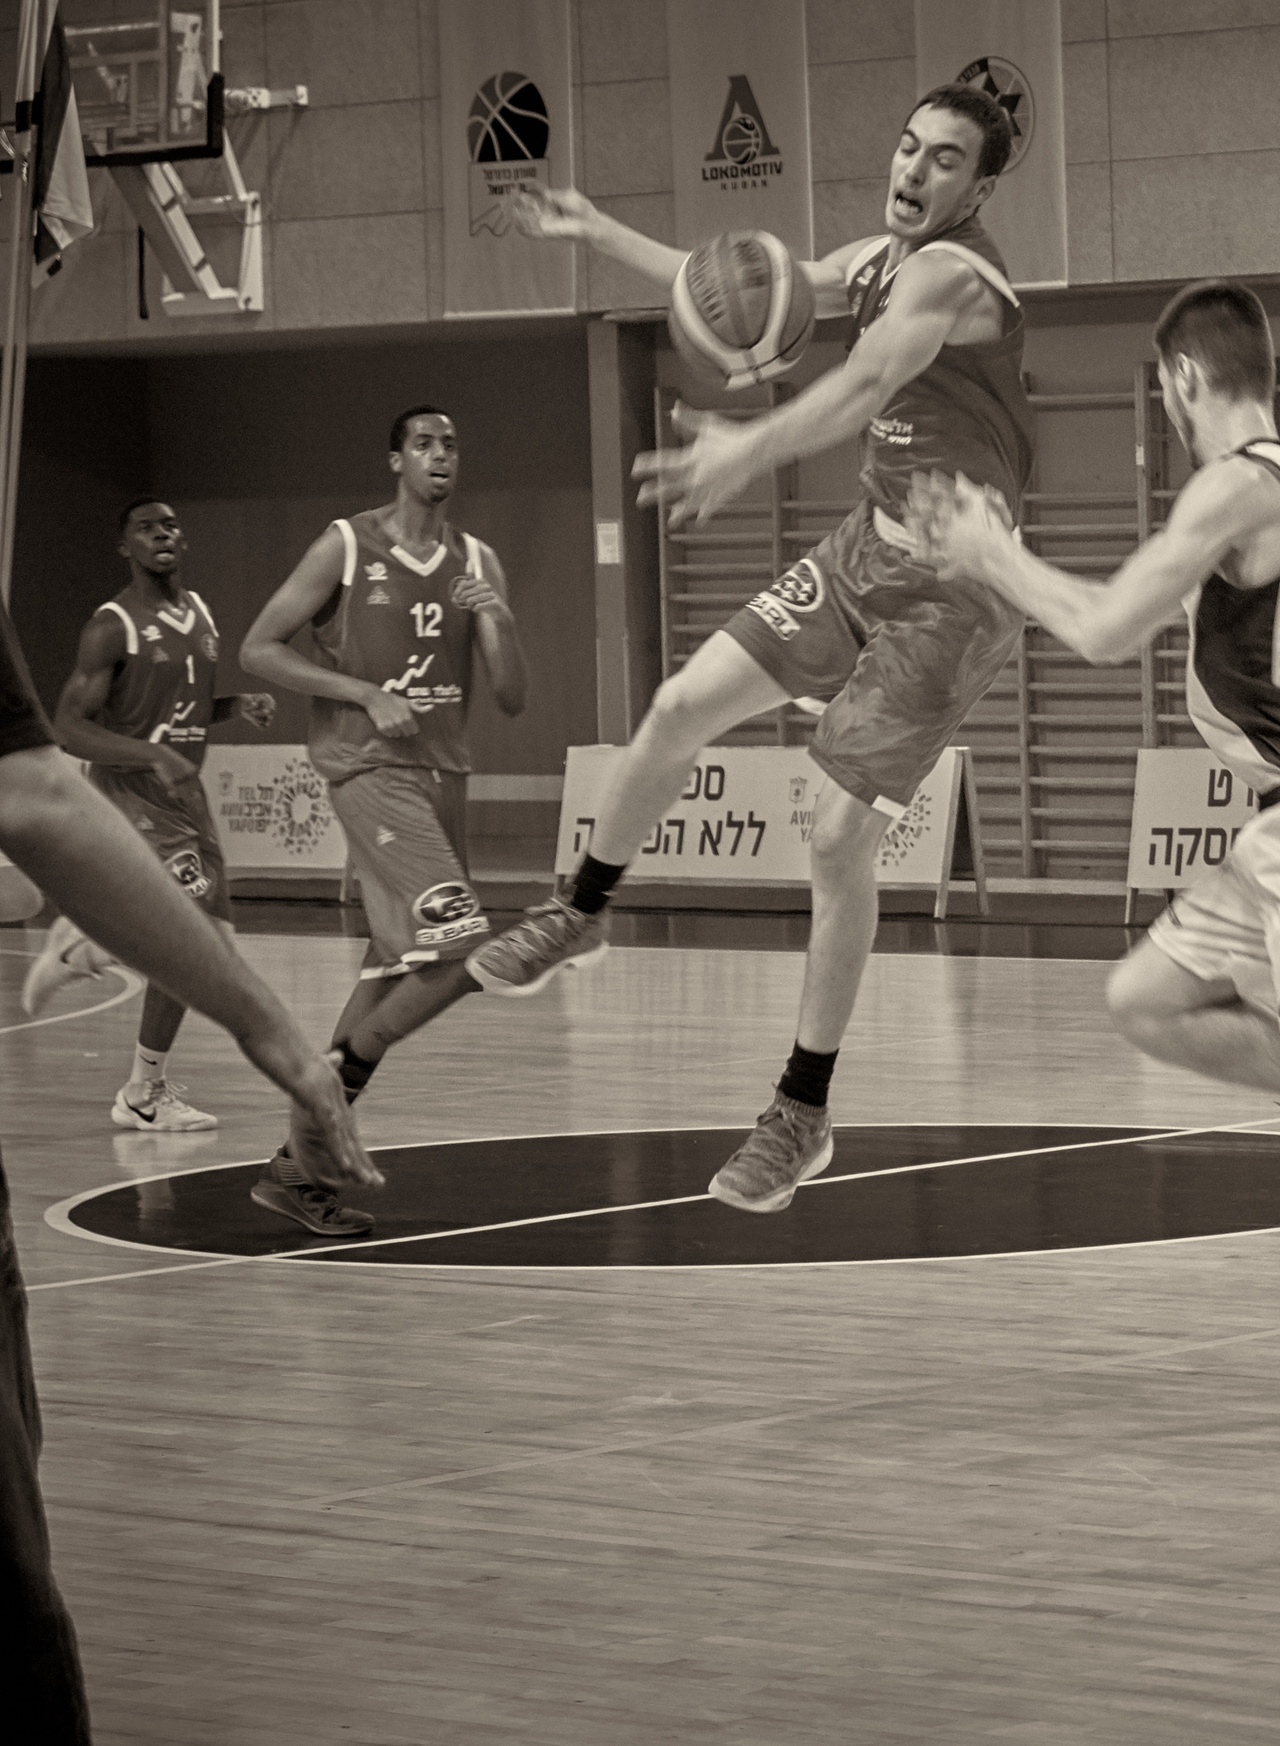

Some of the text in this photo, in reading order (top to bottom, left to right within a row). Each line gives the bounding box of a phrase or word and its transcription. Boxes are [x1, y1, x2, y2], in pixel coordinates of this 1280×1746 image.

[702, 162, 782, 181] LOKOMOTIV
[721, 180, 767, 190] KUBAN
[409, 602, 443, 637] 12
[185, 654, 195, 684] 1
[790, 811, 811, 826] AVI
[698, 811, 766, 857] ללא
[1149, 827, 1242, 877] סקה
